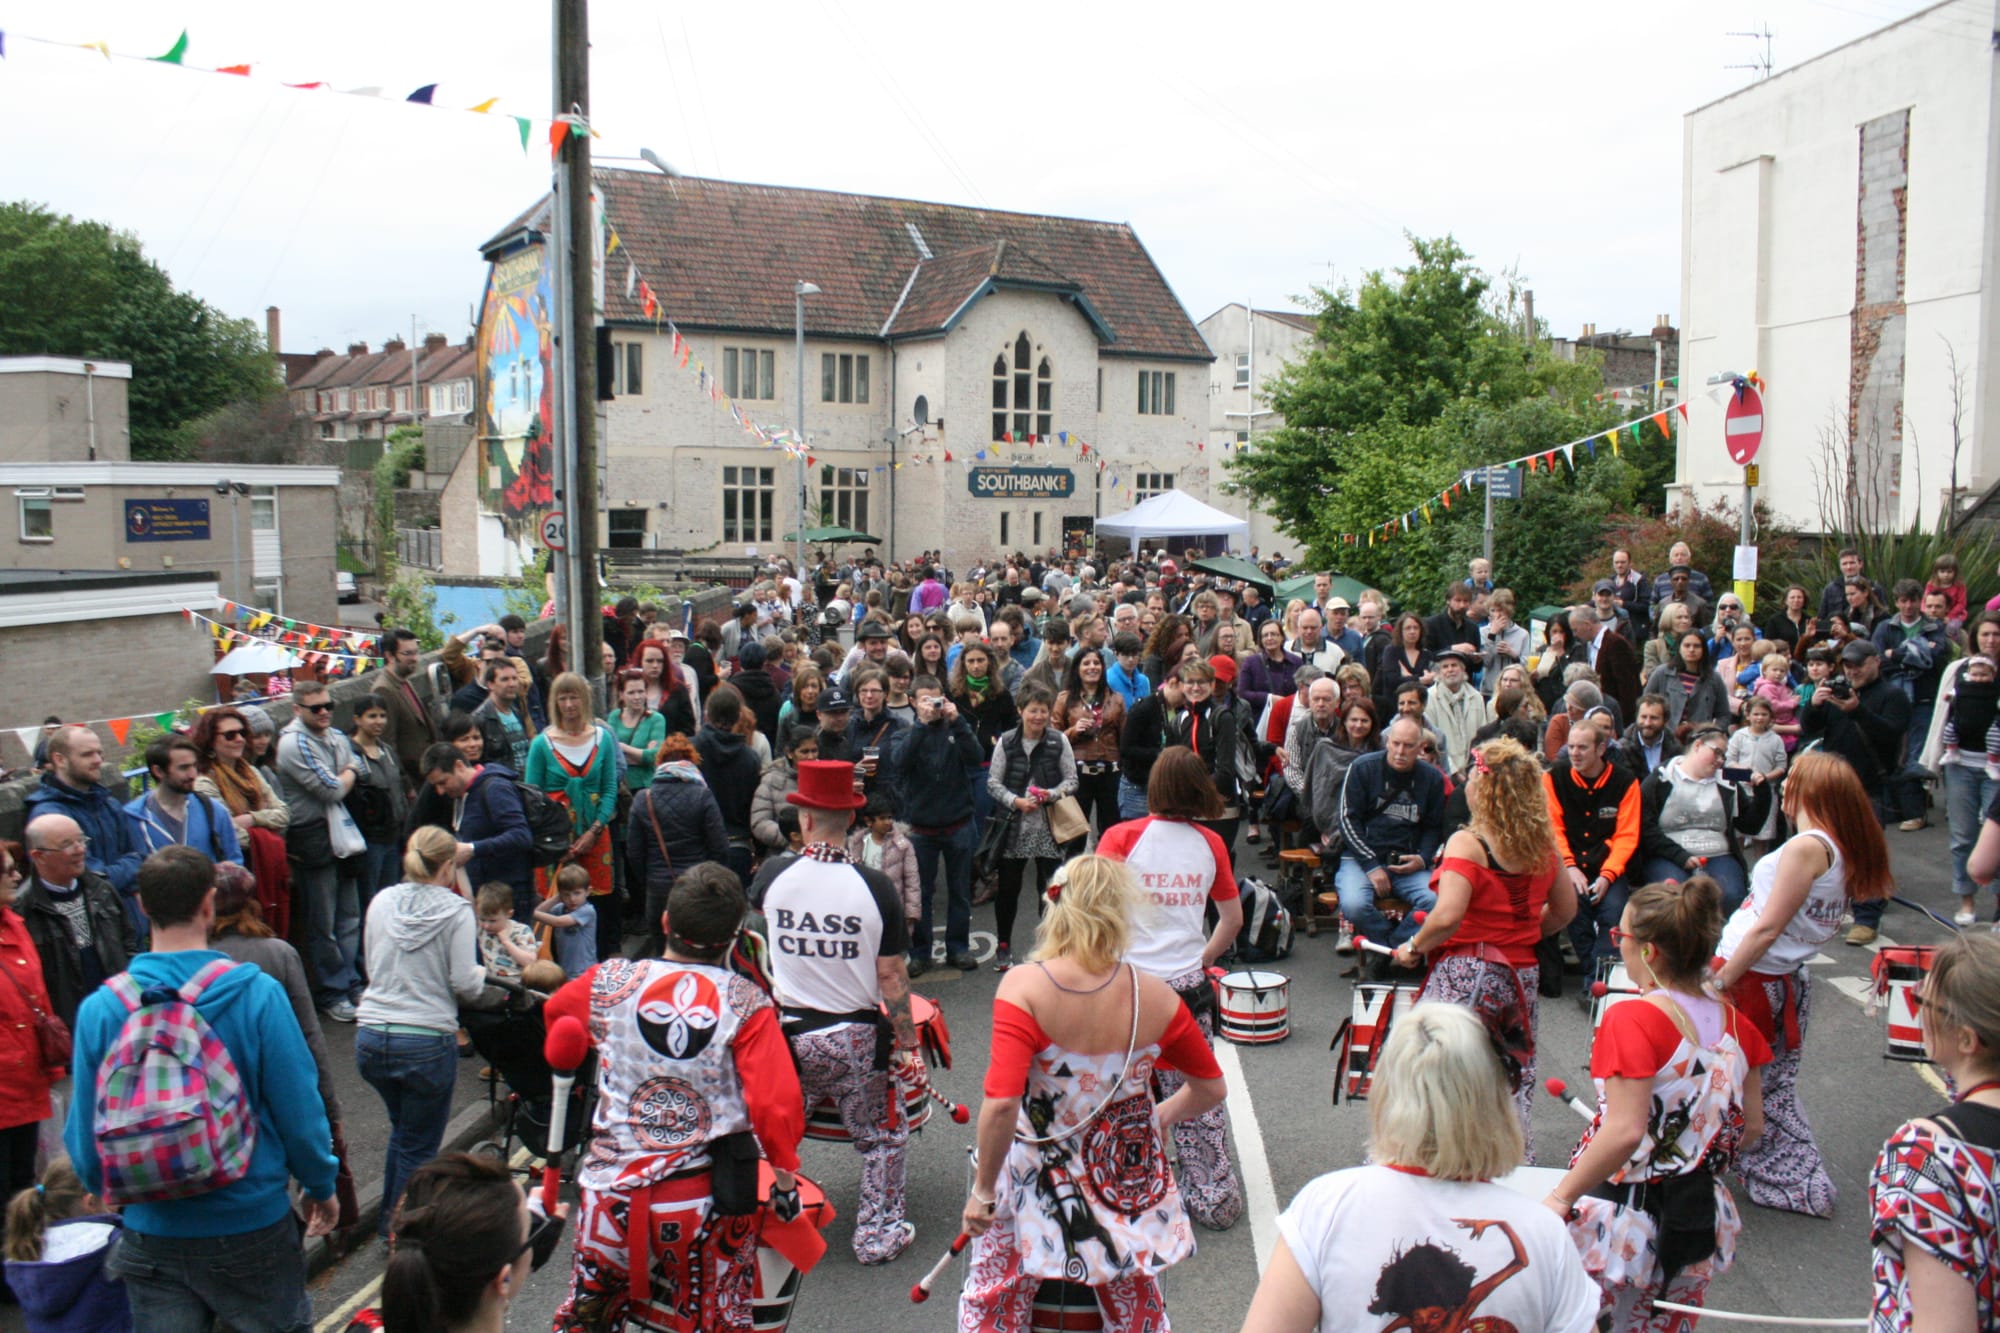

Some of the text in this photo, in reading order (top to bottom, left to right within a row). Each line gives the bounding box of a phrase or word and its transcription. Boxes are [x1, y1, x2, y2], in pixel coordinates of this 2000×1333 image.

[977, 474, 1059, 491] SOUTHBANK
[1142, 873, 1203, 889] TEAM
[775, 908, 863, 935] BASS
[778, 934, 859, 960] CLUB
